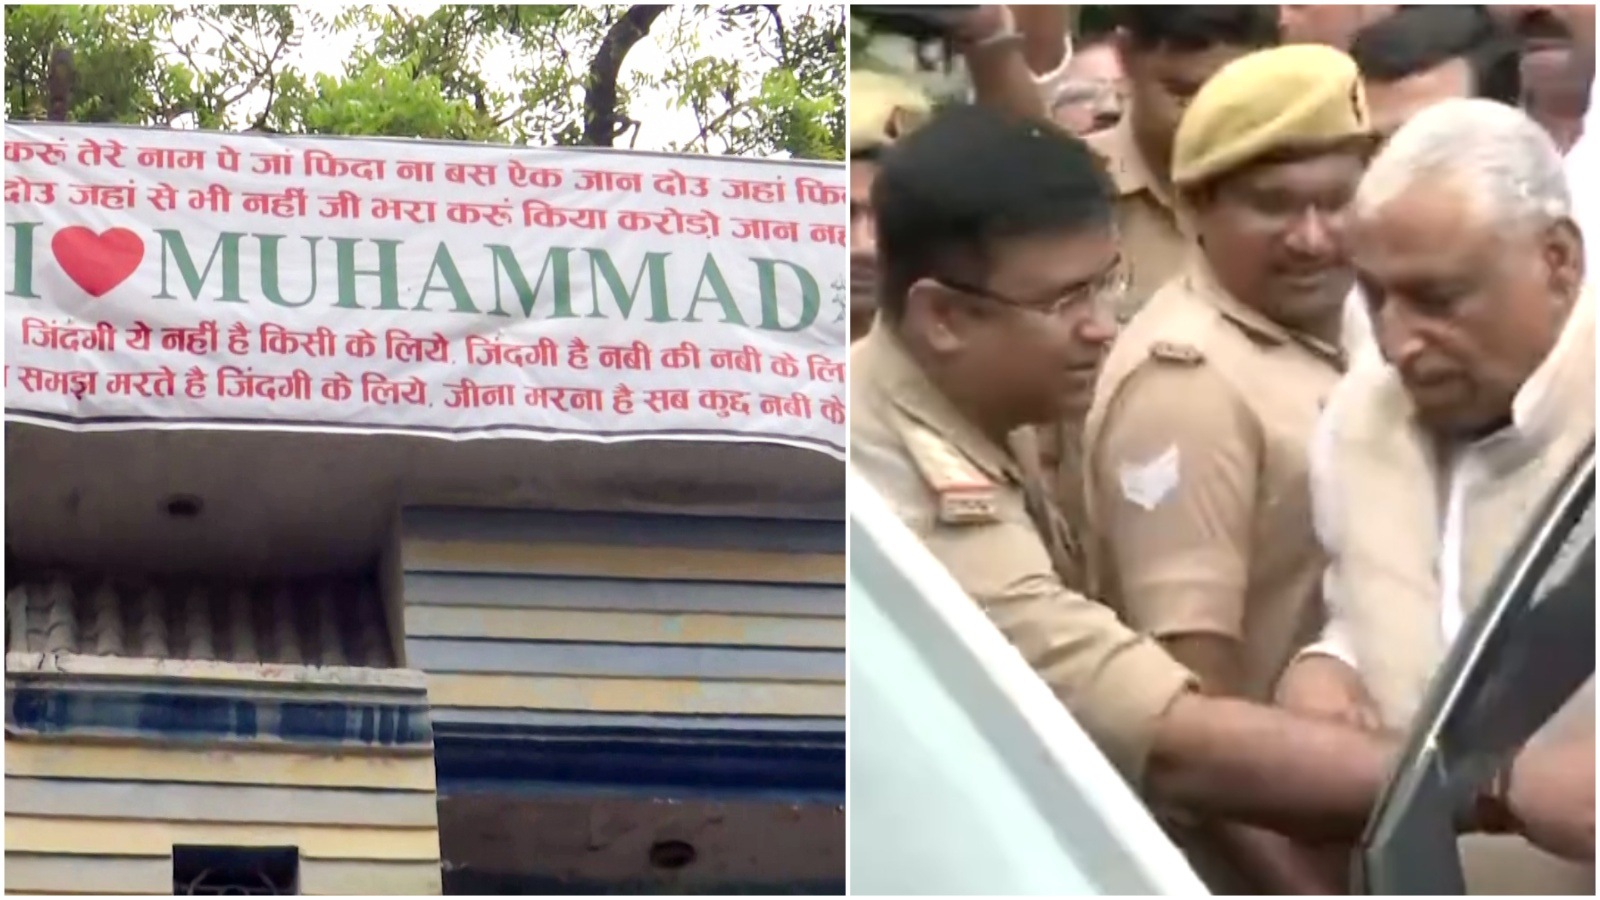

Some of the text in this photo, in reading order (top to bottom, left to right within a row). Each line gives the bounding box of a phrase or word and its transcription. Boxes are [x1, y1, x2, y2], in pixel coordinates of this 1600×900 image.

[78, 139, 128, 169] तेरे
[137, 146, 207, 170] नाम
[216, 146, 242, 172] पे
[251, 148, 294, 176] जां
[304, 150, 386, 180] फिदा
[396, 161, 435, 182] ना
[445, 163, 498, 186] बस
[575, 169, 643, 193] जान
[653, 169, 711, 198] दोउ
[721, 175, 786, 204] जहां
[68, 178, 137, 209] जहां
[147, 182, 179, 211] से
[188, 184, 232, 212] भी
[242, 187, 307, 217] नहीं
[318, 191, 362, 219] जी
[372, 197, 436, 223] भरा
[447, 198, 514, 226] करूं
[523, 200, 608, 229] किया
[730, 217, 801, 241] जान
[5, 222, 44, 300] I
[151, 228, 821, 333] MUHAMMAD
[22, 317, 116, 353] जिंदगी
[126, 321, 153, 351] ये
[161, 319, 220, 355] नहीं
[228, 321, 251, 355] है
[260, 322, 338, 357] किसी
[345, 329, 377, 357] के
[466, 334, 560, 367] जिंदगी
[567, 336, 590, 370] है
[598, 340, 651, 371] नबी
[660, 341, 701, 369] की
[710, 345, 763, 373] नबी
[771, 352, 802, 378] के
[18, 364, 99, 400] समझ
[106, 366, 176, 397] मरते
[185, 364, 210, 399] है
[218, 366, 313, 401] जिंदगी
[322, 371, 353, 401] के
[443, 377, 516, 409] जीना
[524, 385, 605, 412] मरना
[612, 383, 635, 414] है
[644, 388, 691, 413] सब
[760, 392, 813, 418] नबी
[820, 394, 845, 424] के
